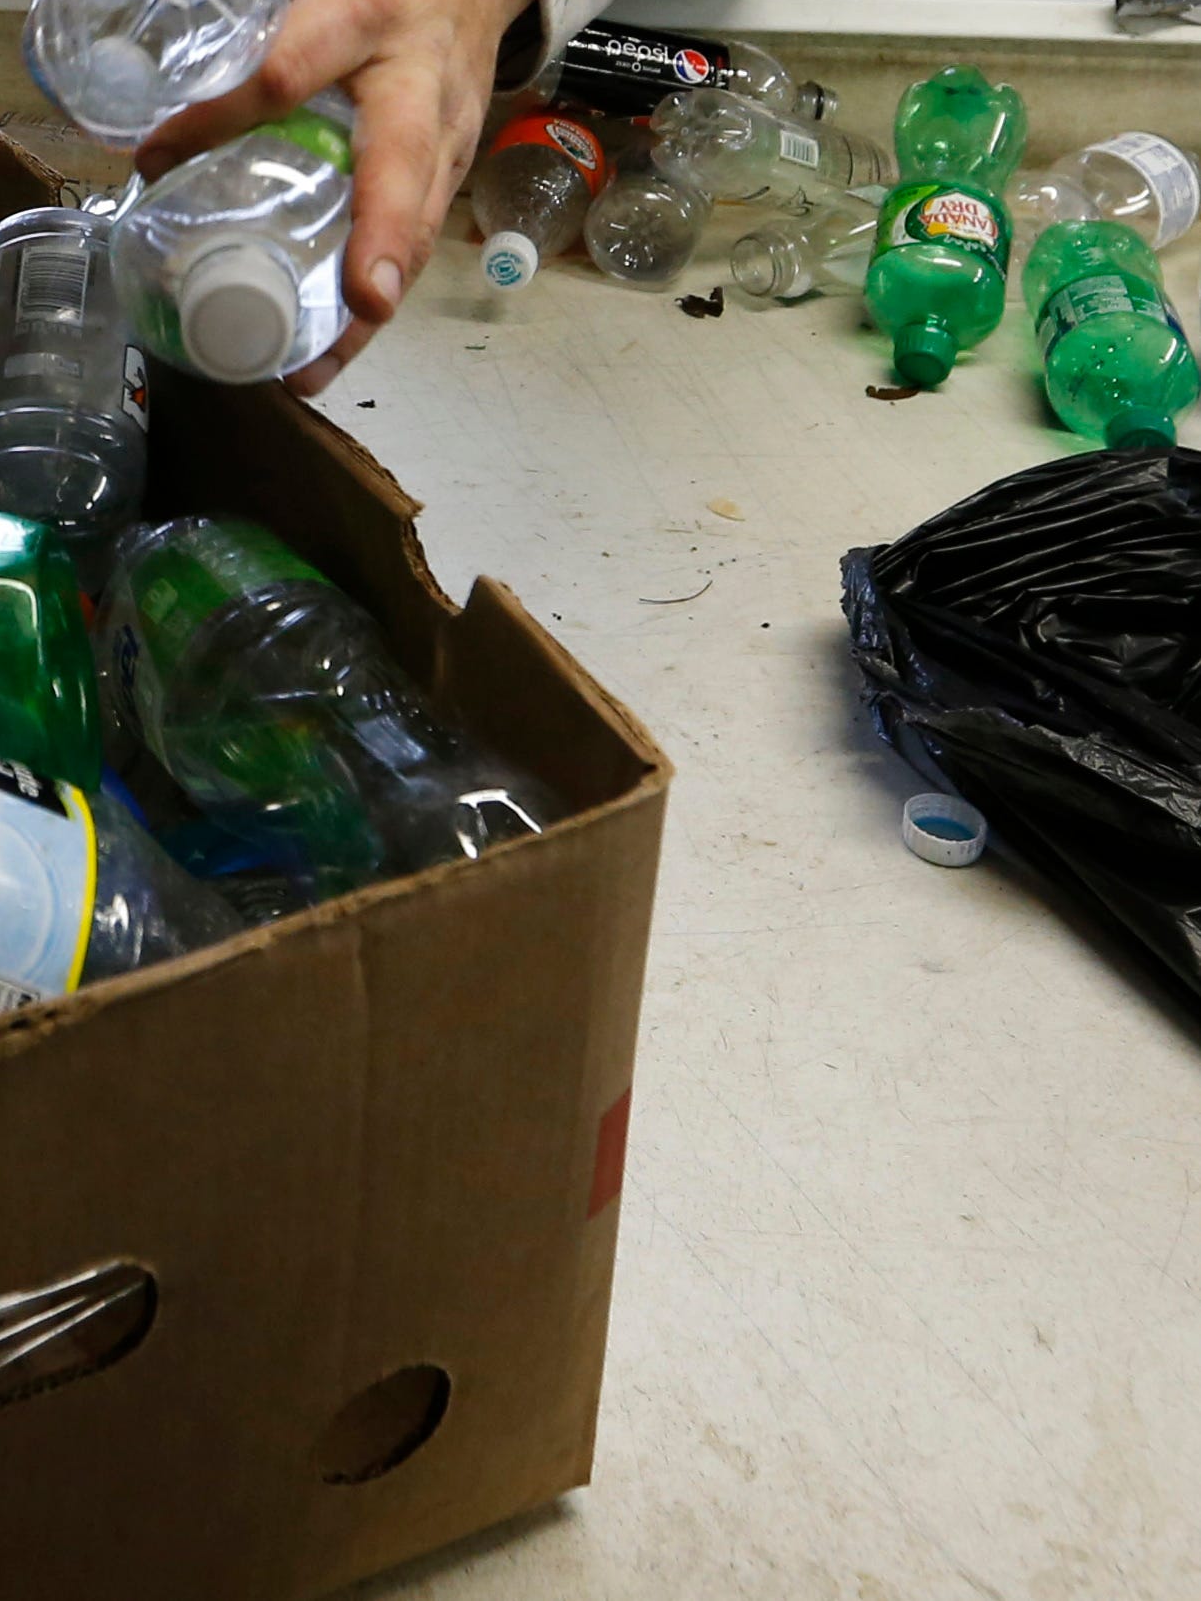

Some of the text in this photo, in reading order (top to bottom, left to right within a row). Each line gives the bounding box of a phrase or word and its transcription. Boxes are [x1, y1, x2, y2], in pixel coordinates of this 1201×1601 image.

[607, 40, 675, 64] pepsi
[940, 201, 979, 215] DRY
[919, 213, 997, 239] CANADA
